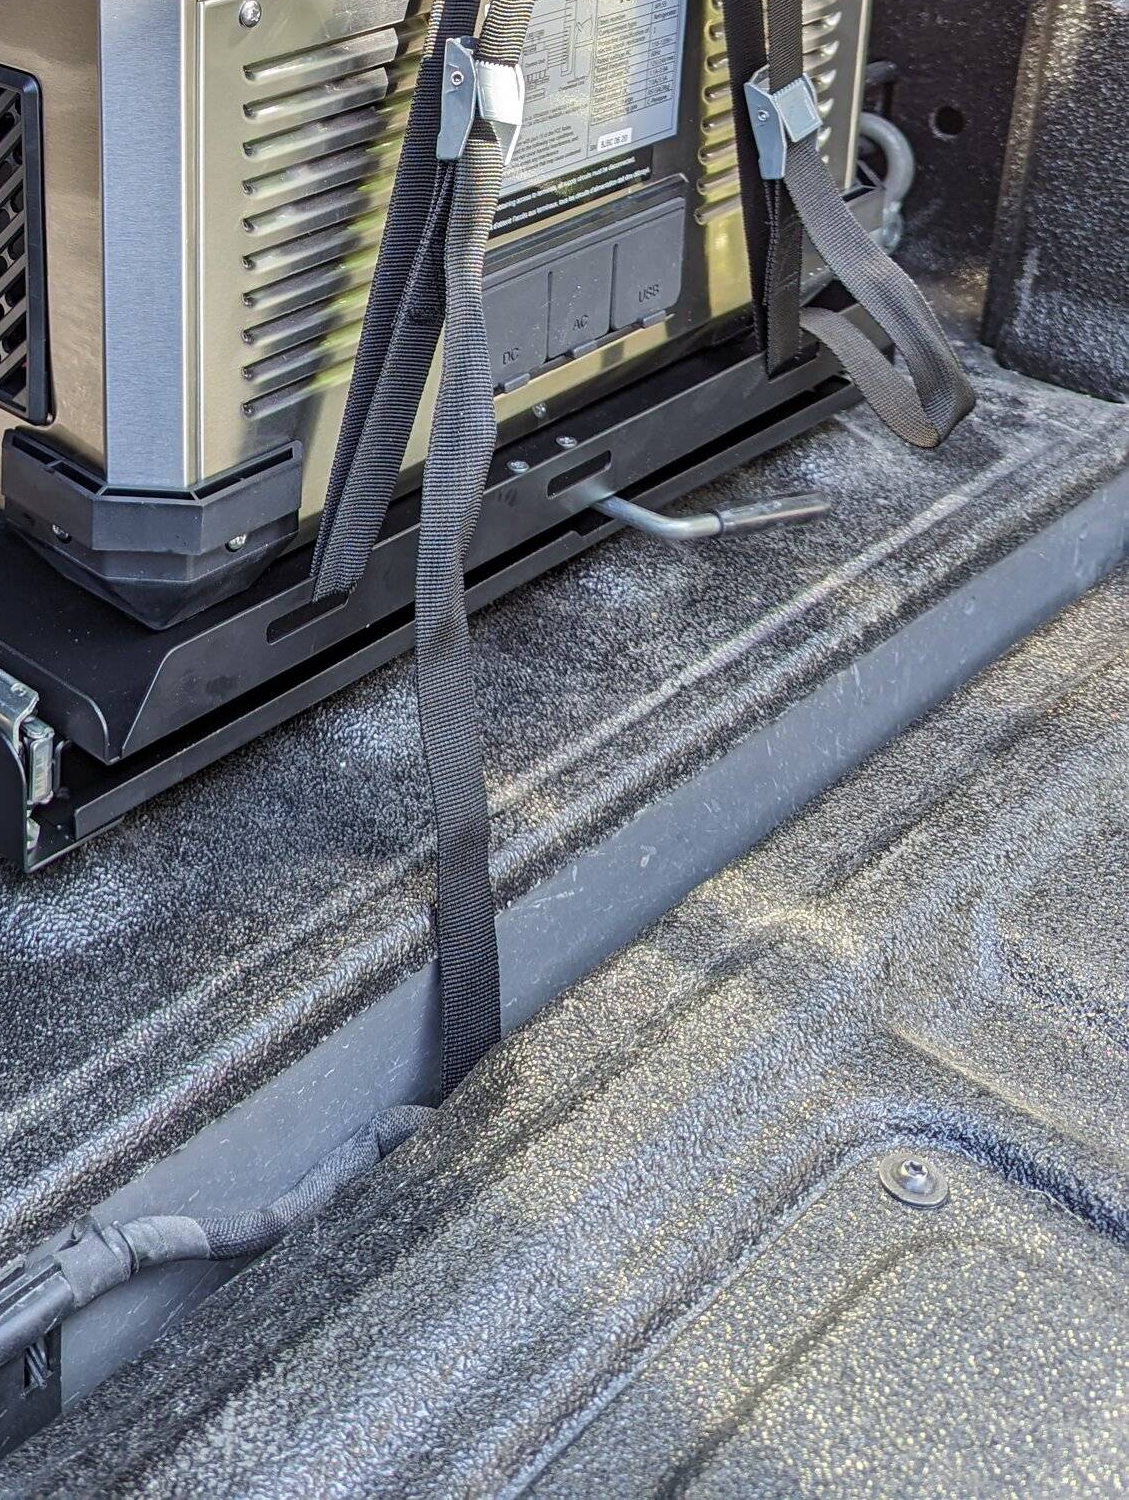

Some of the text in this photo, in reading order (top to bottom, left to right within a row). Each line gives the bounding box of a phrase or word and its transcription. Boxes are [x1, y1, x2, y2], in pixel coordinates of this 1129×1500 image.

[638, 284, 659, 303] USB
[572, 314, 588, 331] AC
[502, 347, 519, 365] DC
